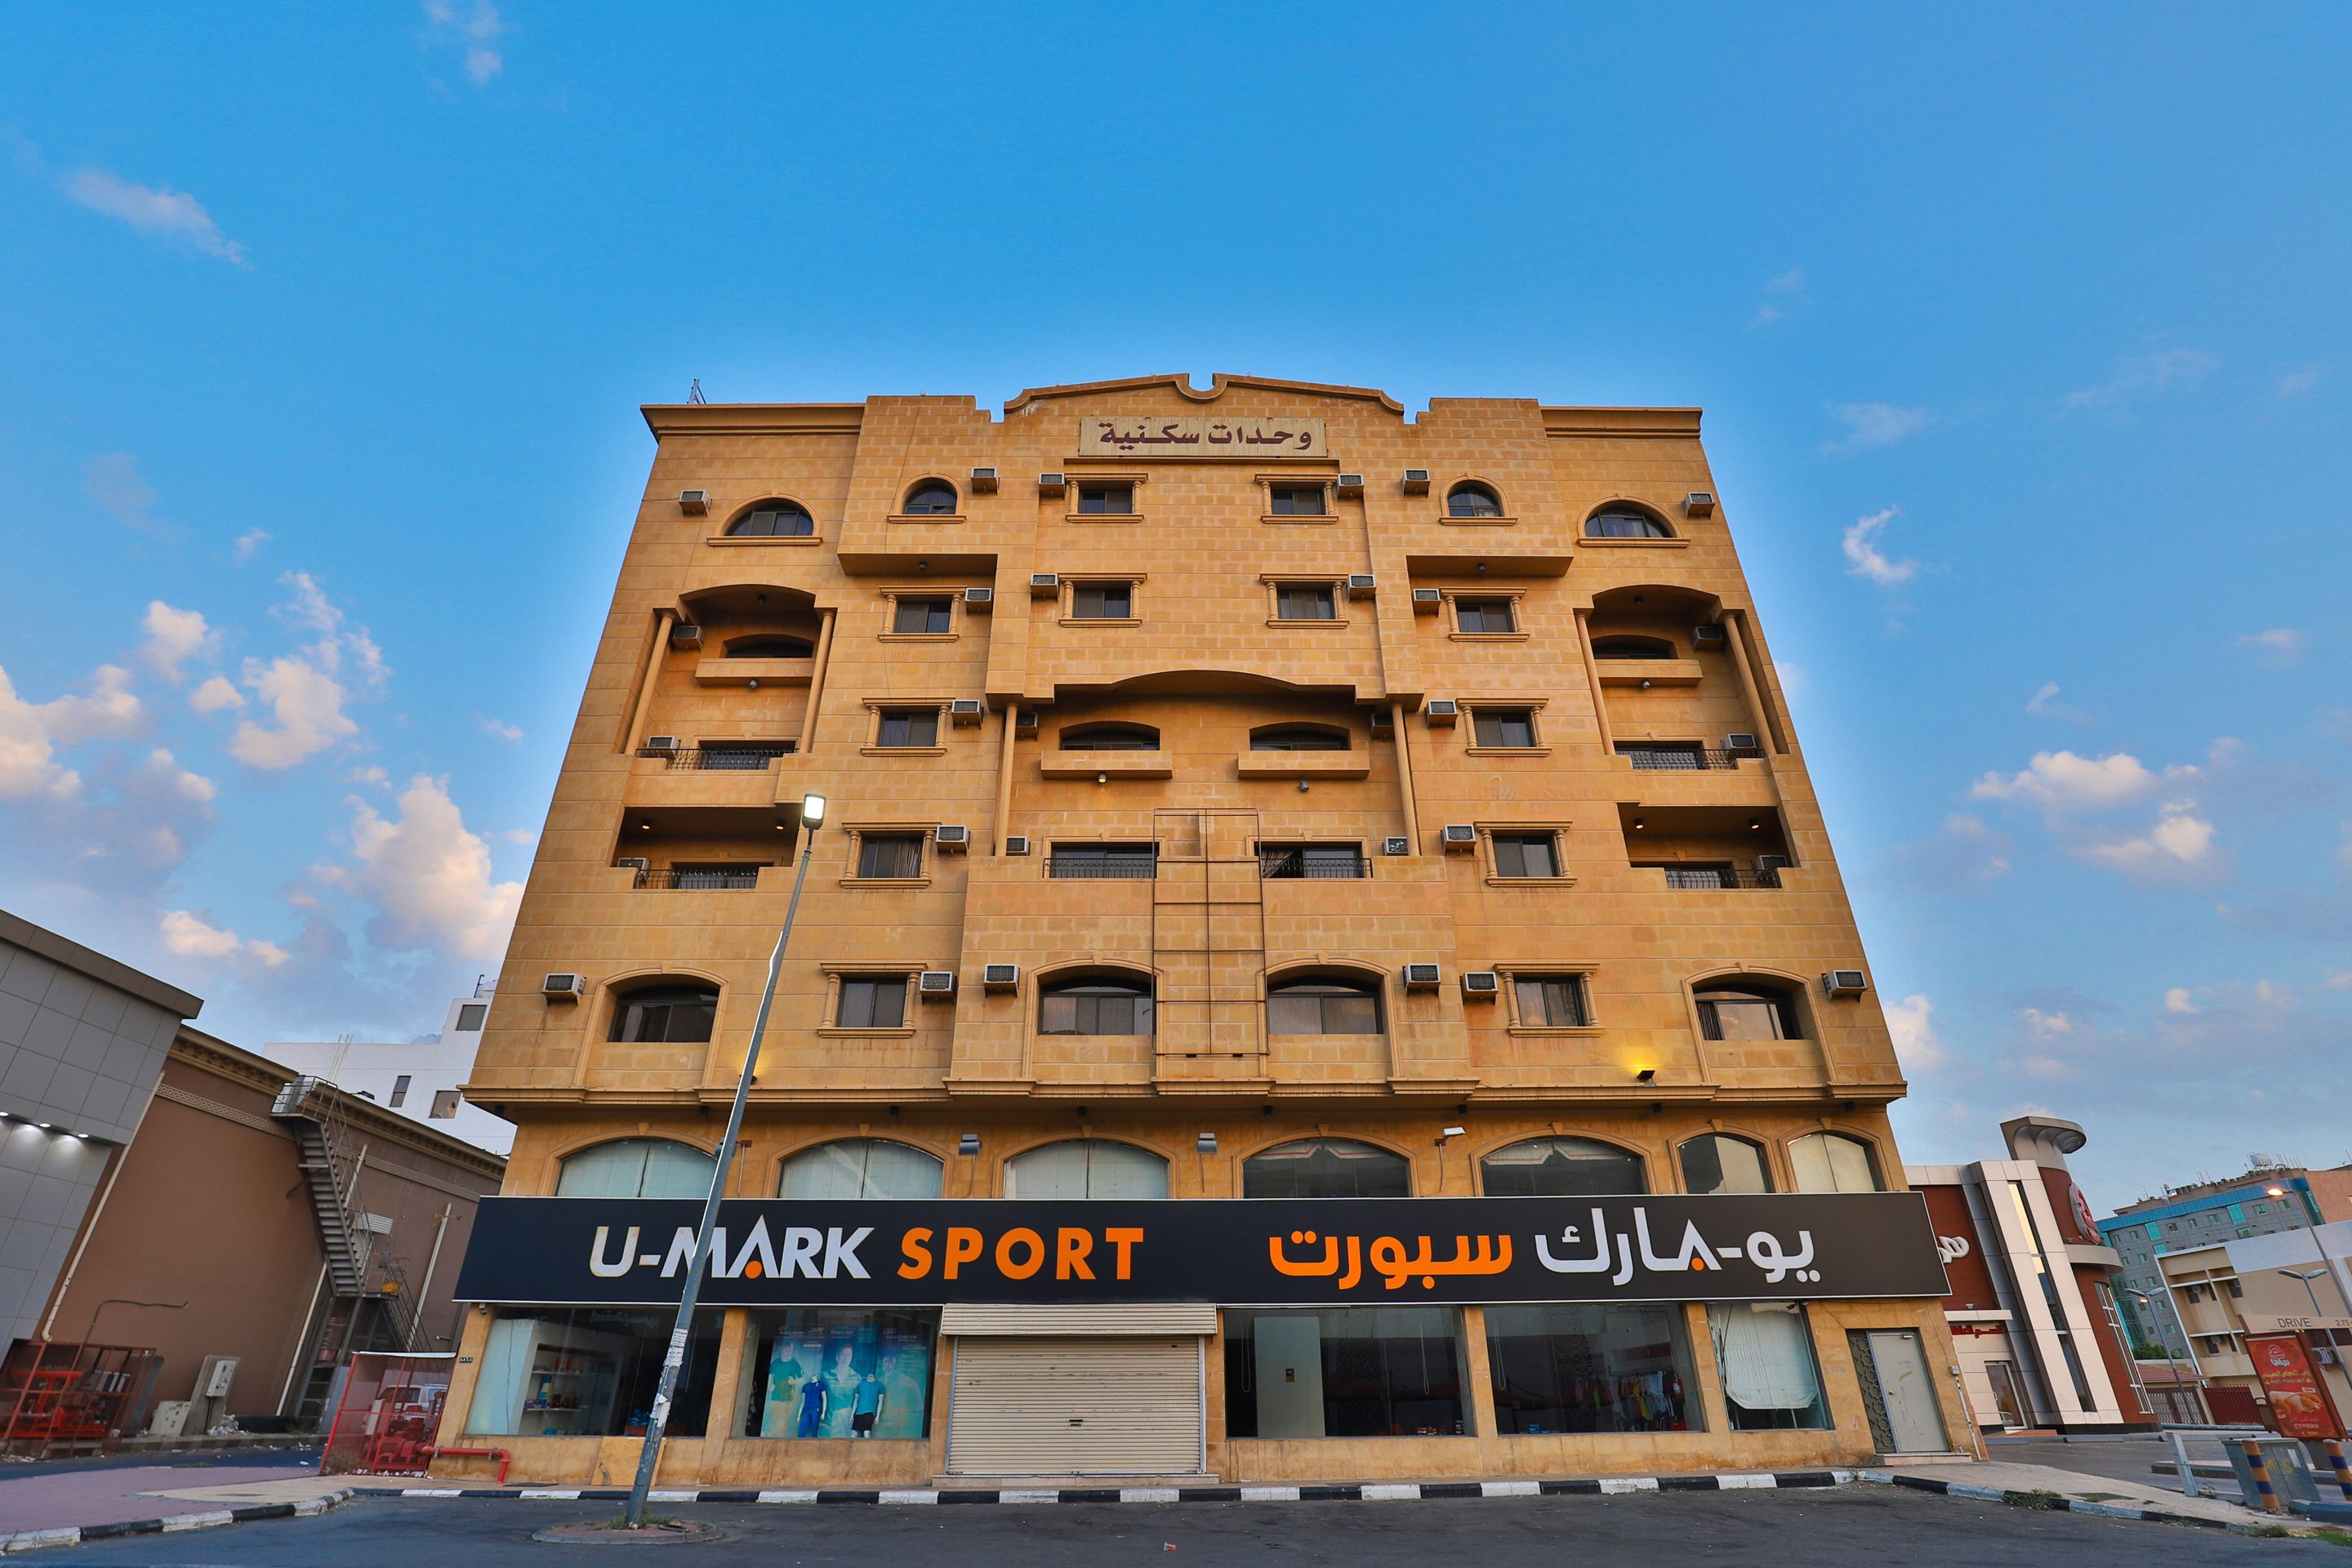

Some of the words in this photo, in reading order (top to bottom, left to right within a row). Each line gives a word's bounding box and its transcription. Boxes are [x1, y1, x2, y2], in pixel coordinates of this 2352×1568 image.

[1098, 422, 1200, 451] سكنية
[1207, 424, 1312, 451] وحدات
[589, 1214, 875, 1279] U-MARK
[897, 1227, 1144, 1280] SPORT
[1269, 1230, 1513, 1290] سبورت
[2277, 1317, 2312, 1328] DRIVE
